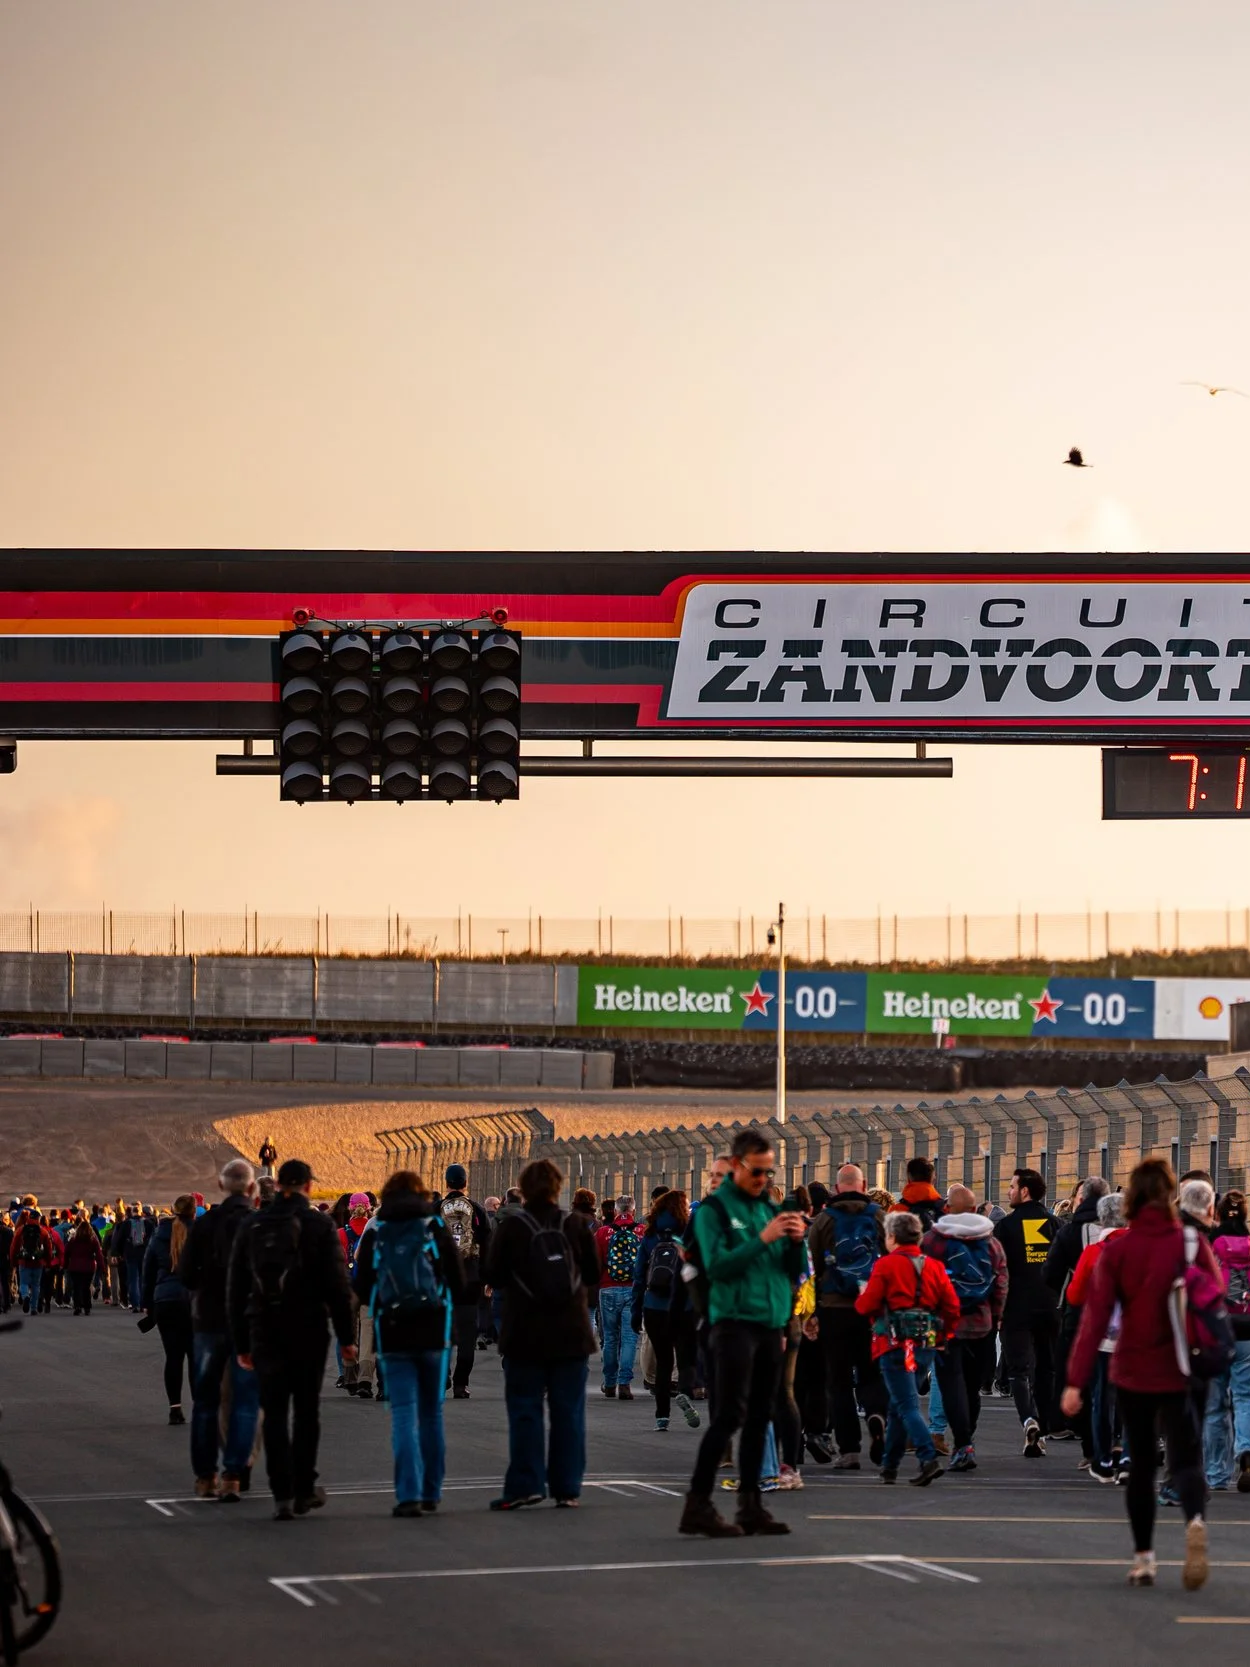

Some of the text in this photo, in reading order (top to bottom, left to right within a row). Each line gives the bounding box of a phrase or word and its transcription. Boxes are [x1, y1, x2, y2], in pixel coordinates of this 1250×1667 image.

[594, 984, 837, 1018] Heineken 0.0
[883, 991, 1126, 1025] Heineken 0.0
